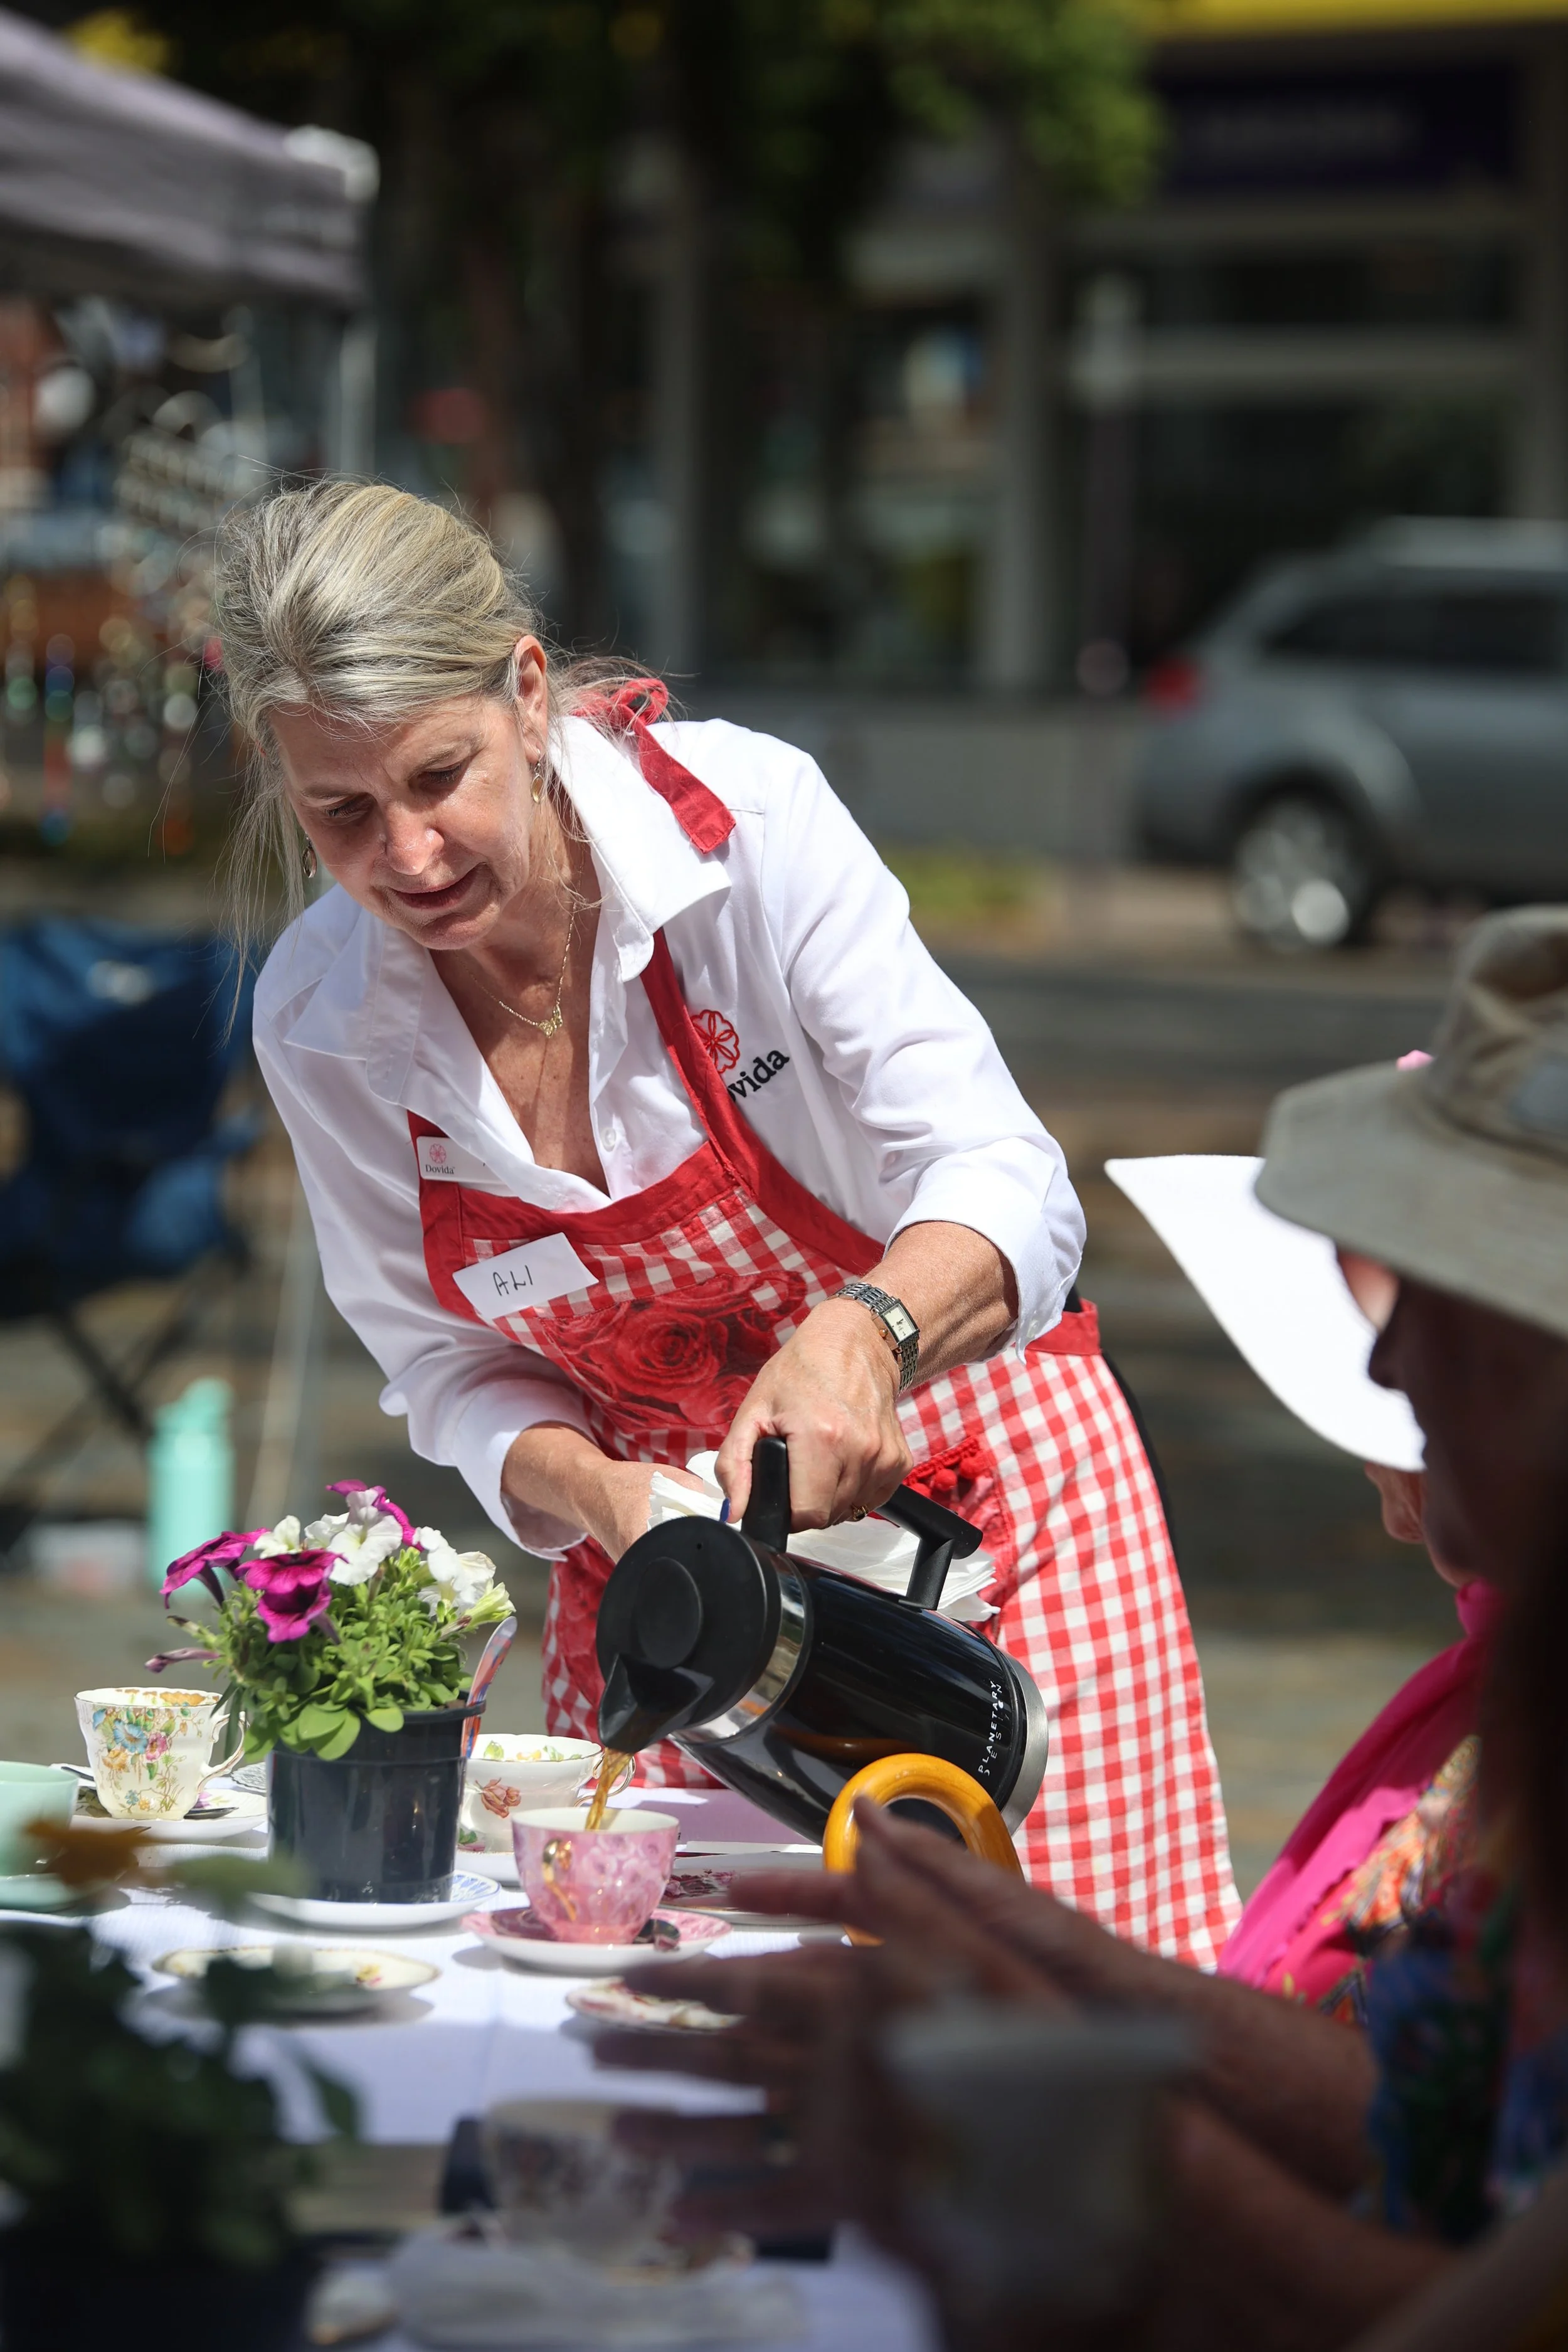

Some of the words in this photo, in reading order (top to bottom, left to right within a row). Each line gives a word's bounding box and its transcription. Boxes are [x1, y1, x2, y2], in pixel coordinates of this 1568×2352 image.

[425, 1164, 454, 1174] Dovida
[493, 1265, 533, 1296] ALI
[978, 1680, 999, 1773] PLANETARY
